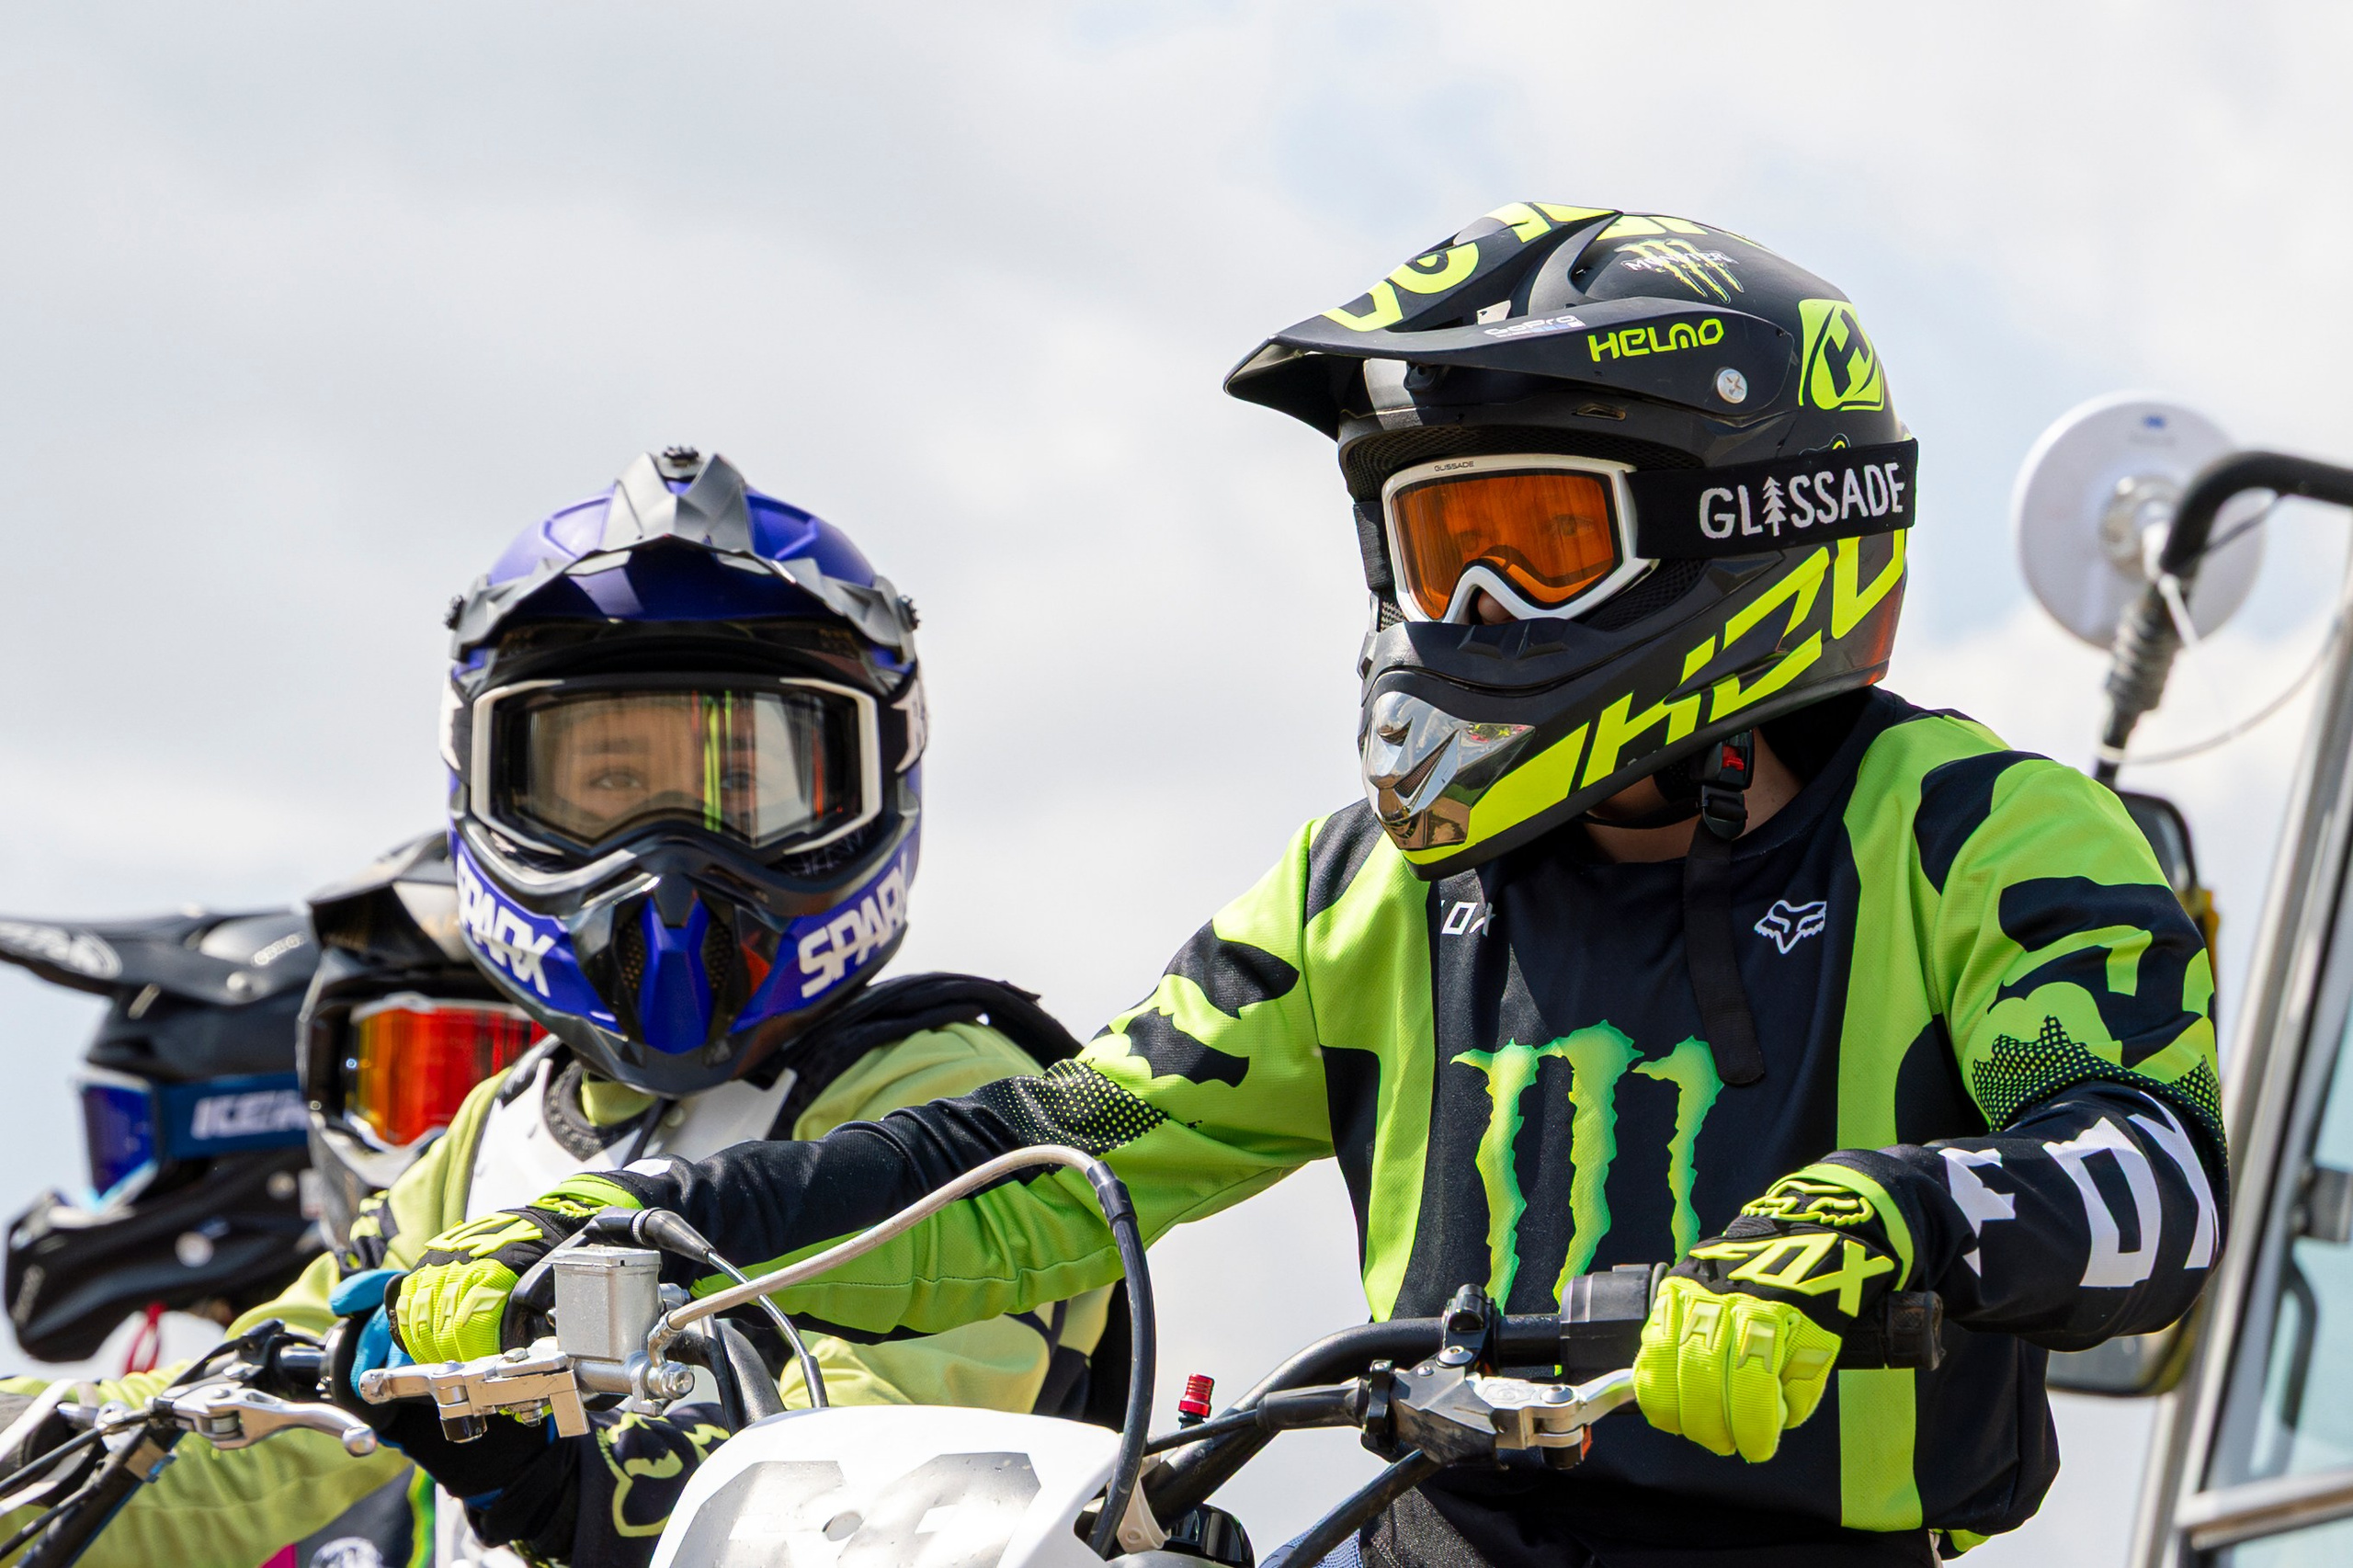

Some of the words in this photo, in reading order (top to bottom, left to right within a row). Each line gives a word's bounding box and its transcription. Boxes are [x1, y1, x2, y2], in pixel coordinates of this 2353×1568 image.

[1434, 460, 1474, 472] GLISSADE
[1699, 462, 1905, 539] GLISSADE
[1440, 900, 1496, 937] OX
[1688, 1233, 1895, 1318] FOX
